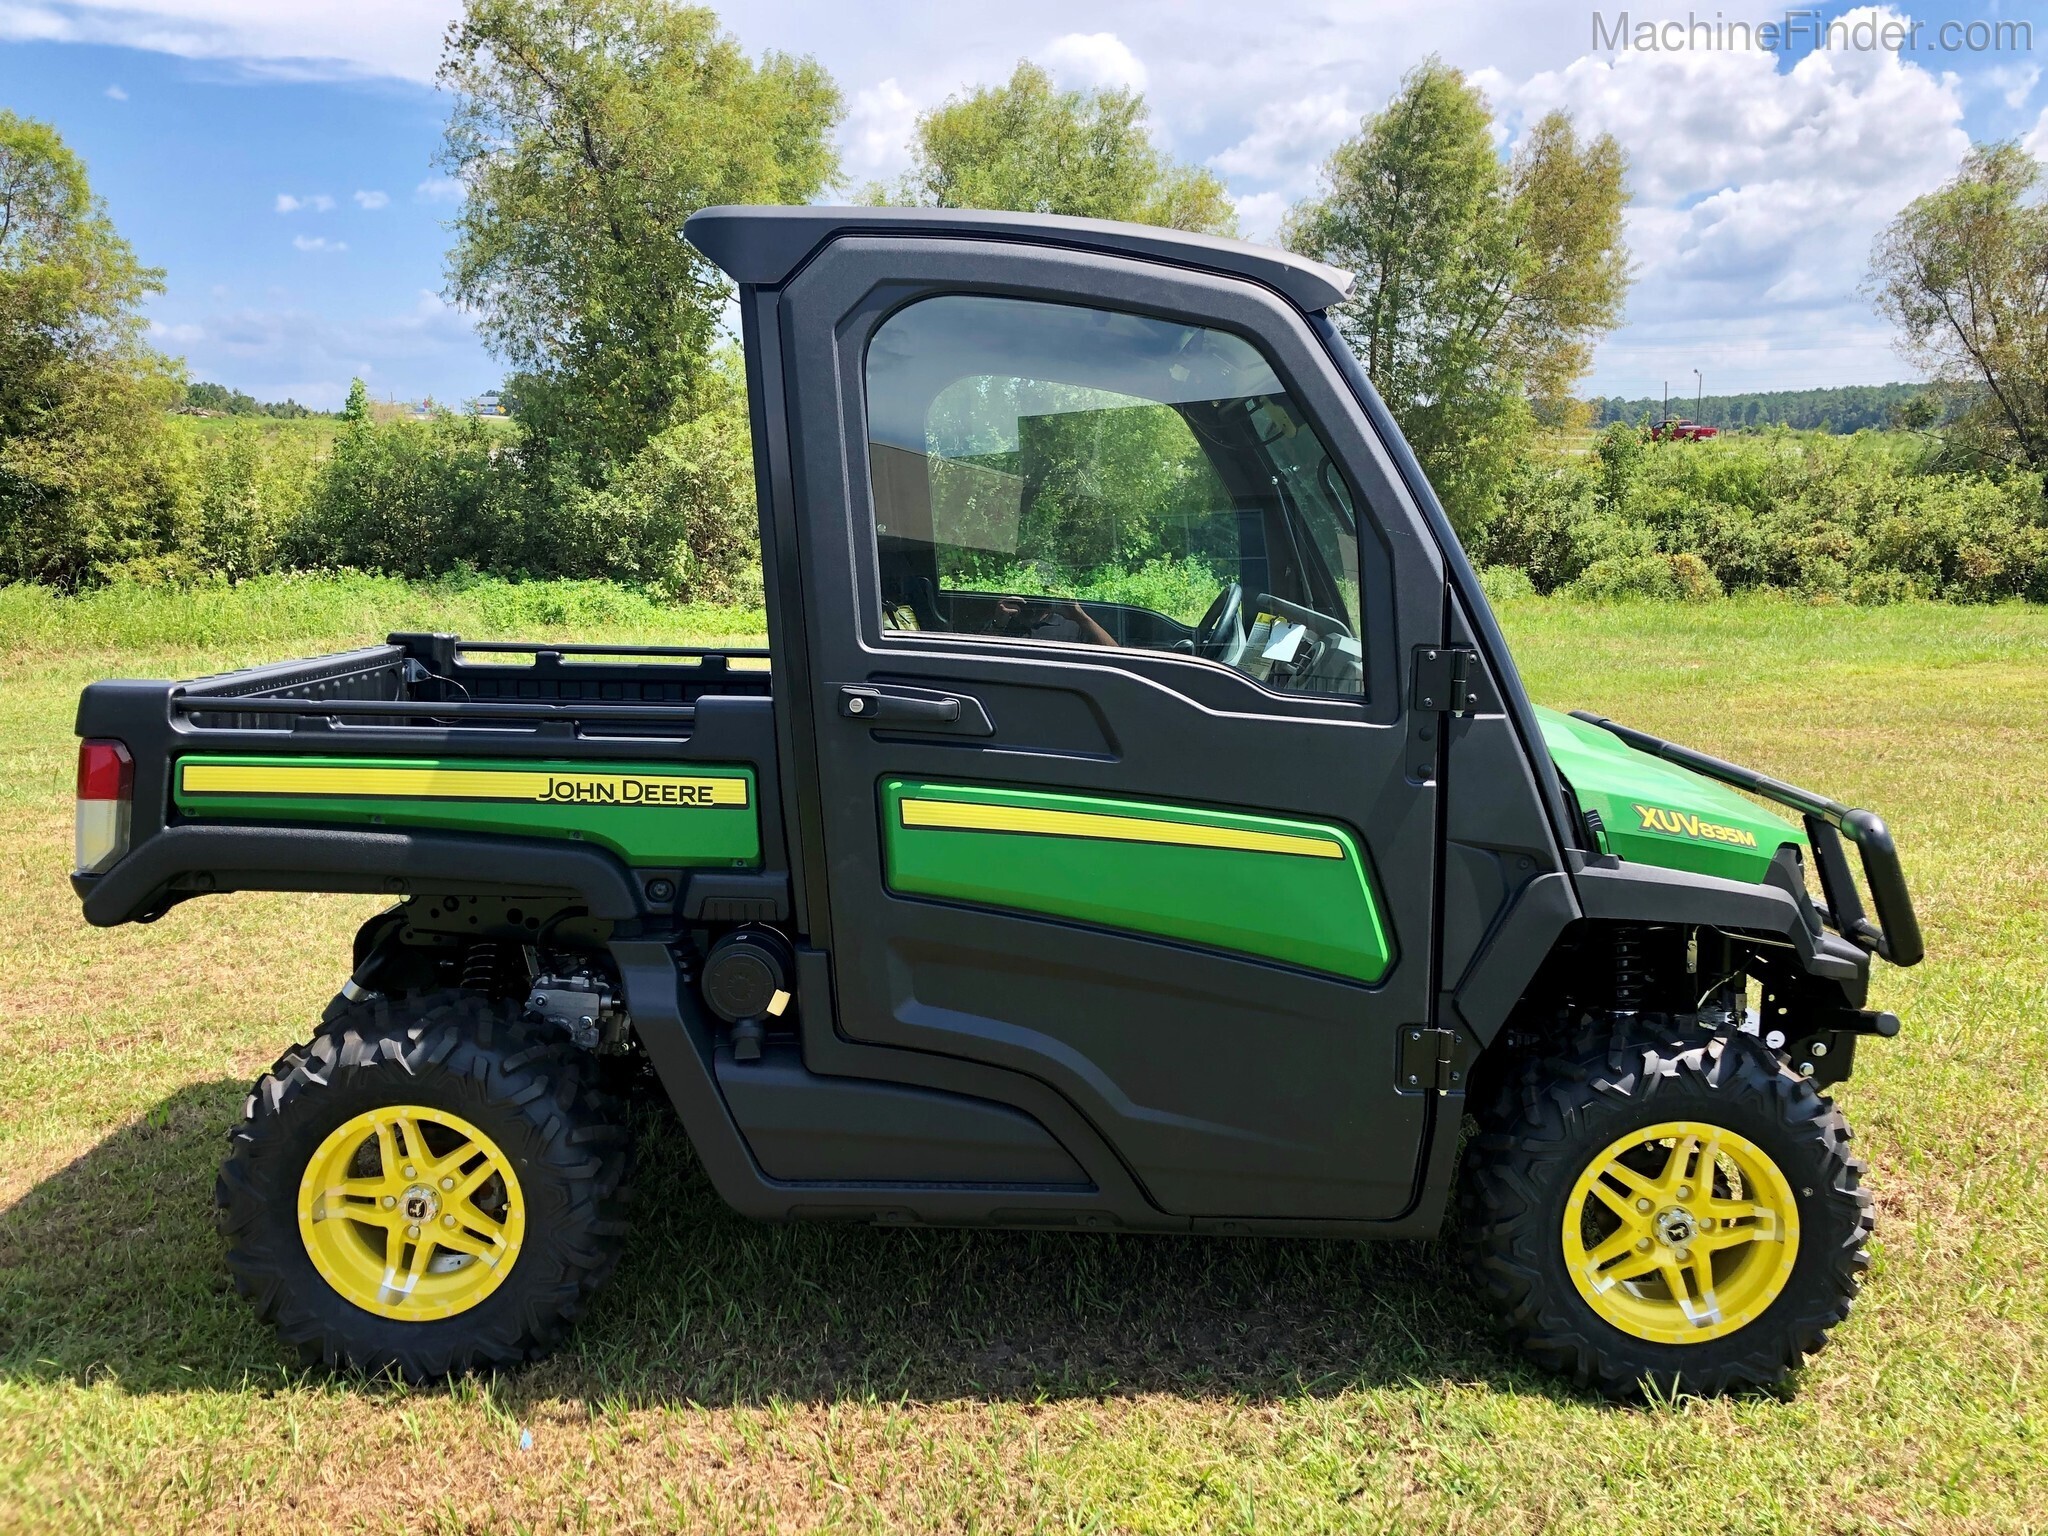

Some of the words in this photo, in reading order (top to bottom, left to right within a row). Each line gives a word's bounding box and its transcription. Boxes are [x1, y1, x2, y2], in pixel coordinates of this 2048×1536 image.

[539, 777, 614, 800] JOHN
[622, 780, 714, 803] DEERE
[1634, 804, 1757, 848] XUV835M
